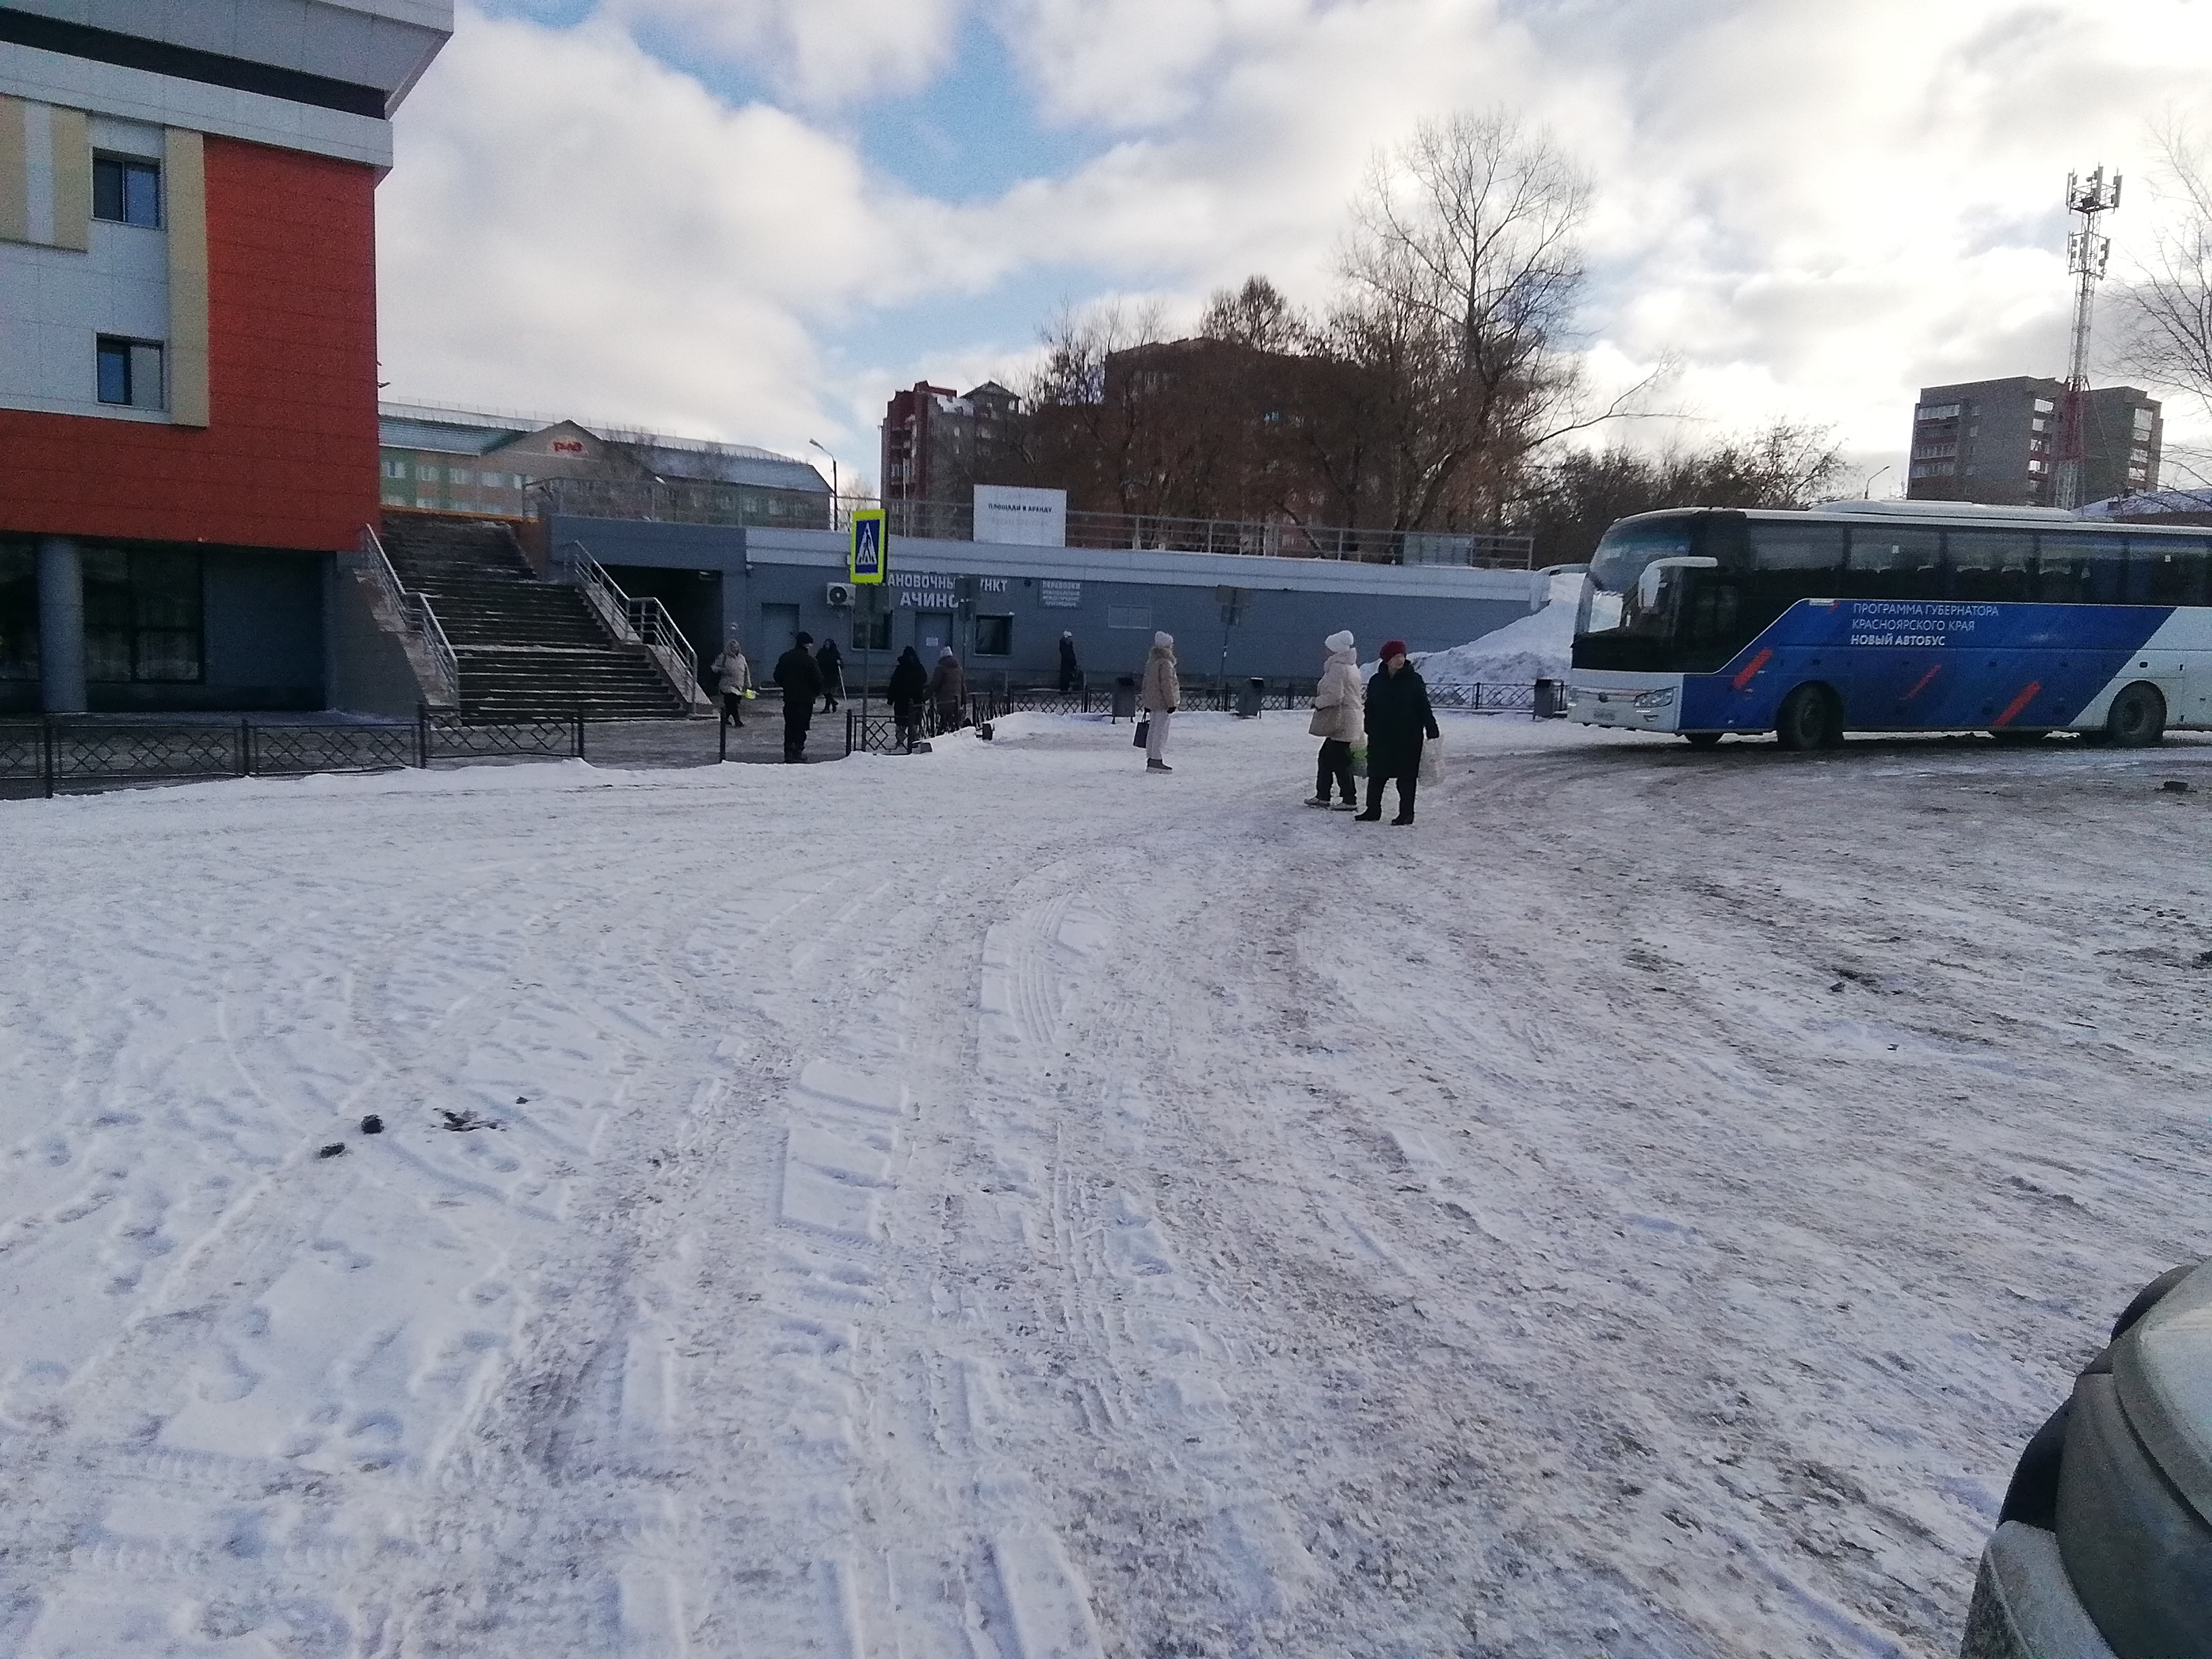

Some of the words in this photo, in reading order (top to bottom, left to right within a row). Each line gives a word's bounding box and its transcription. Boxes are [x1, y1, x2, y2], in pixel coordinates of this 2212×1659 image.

[900, 592, 960, 608] АЧИНС
[1853, 603, 1923, 615] ПРОГРАММА
[1925, 605, 1999, 616] ГУБЕРНАТОРА
[1852, 619, 1945, 631] КРАСНОЯРСКОГО
[1948, 620, 1975, 632] КРАЯ
[1851, 633, 1893, 645] НОВЫЙ
[1895, 635, 1946, 646] АВТОБУС
